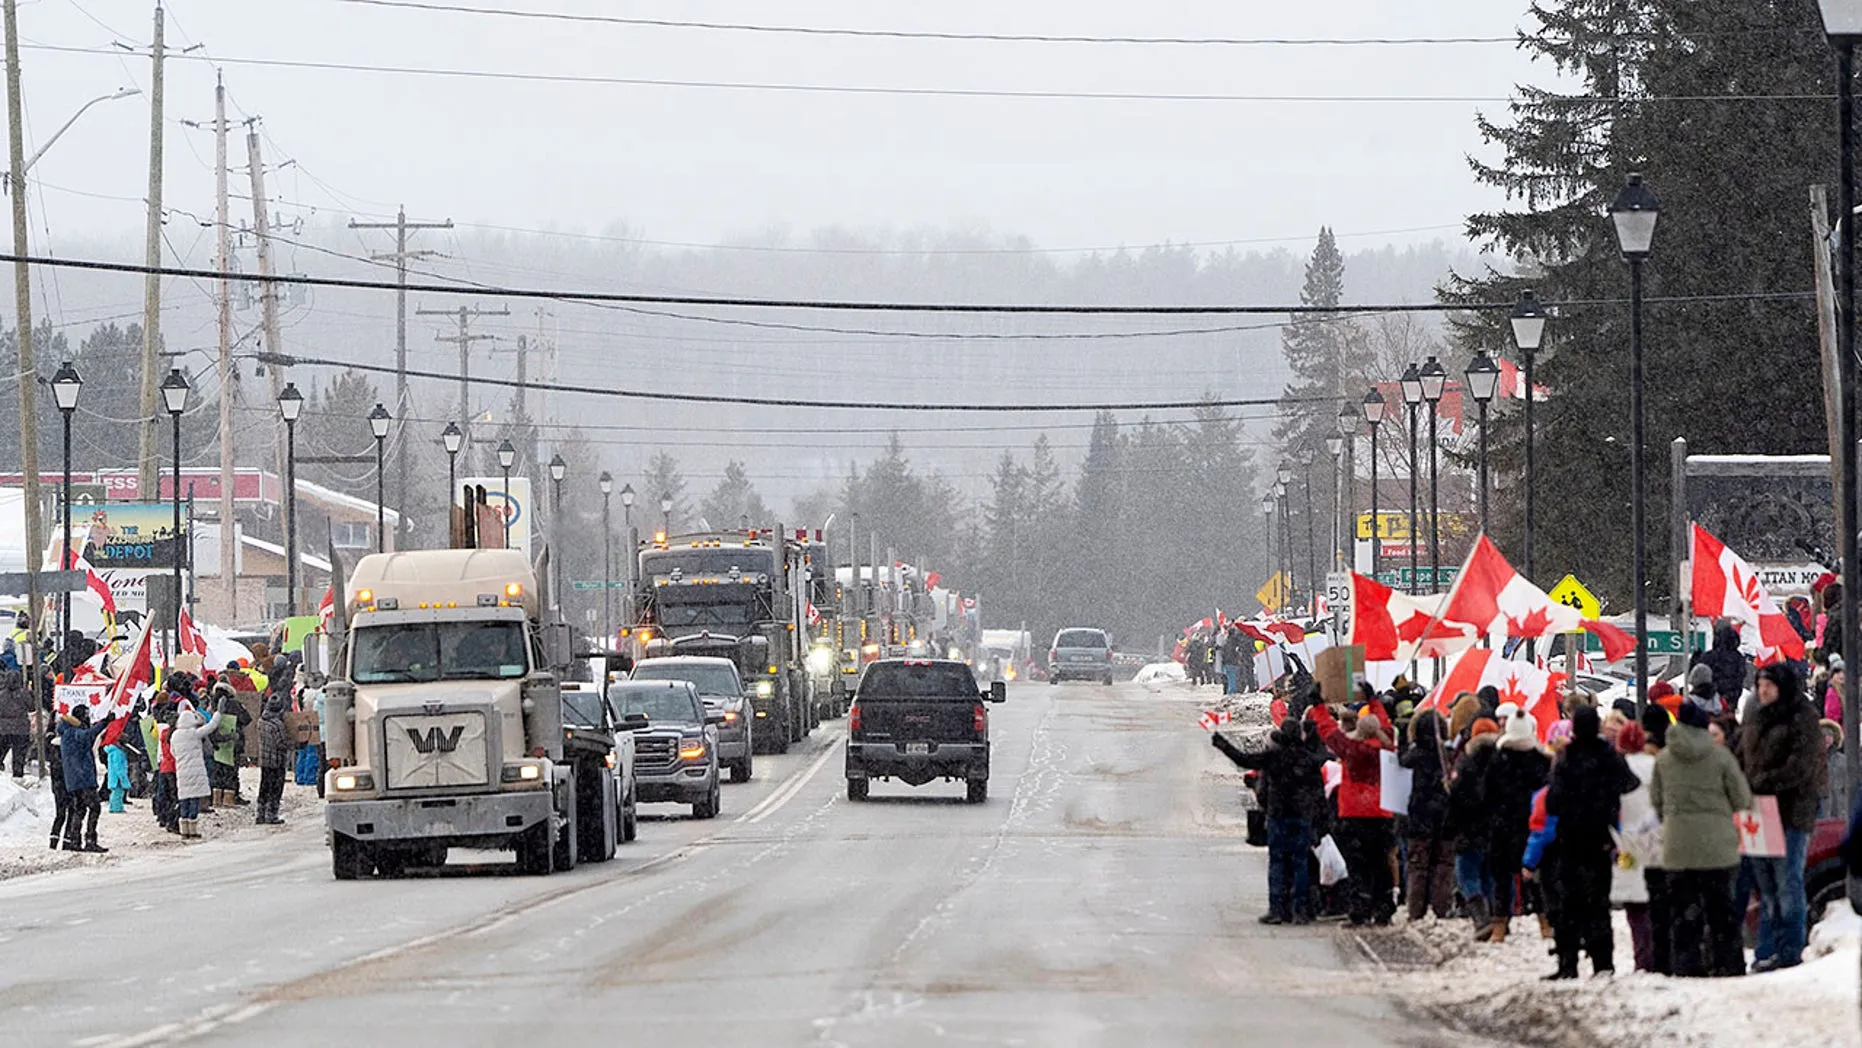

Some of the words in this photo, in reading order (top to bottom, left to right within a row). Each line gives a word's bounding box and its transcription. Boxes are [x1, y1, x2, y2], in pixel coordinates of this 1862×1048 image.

[105, 545, 153, 559] DEPOT
[1329, 586, 1350, 601] 50
[61, 687, 86, 697] THANK
